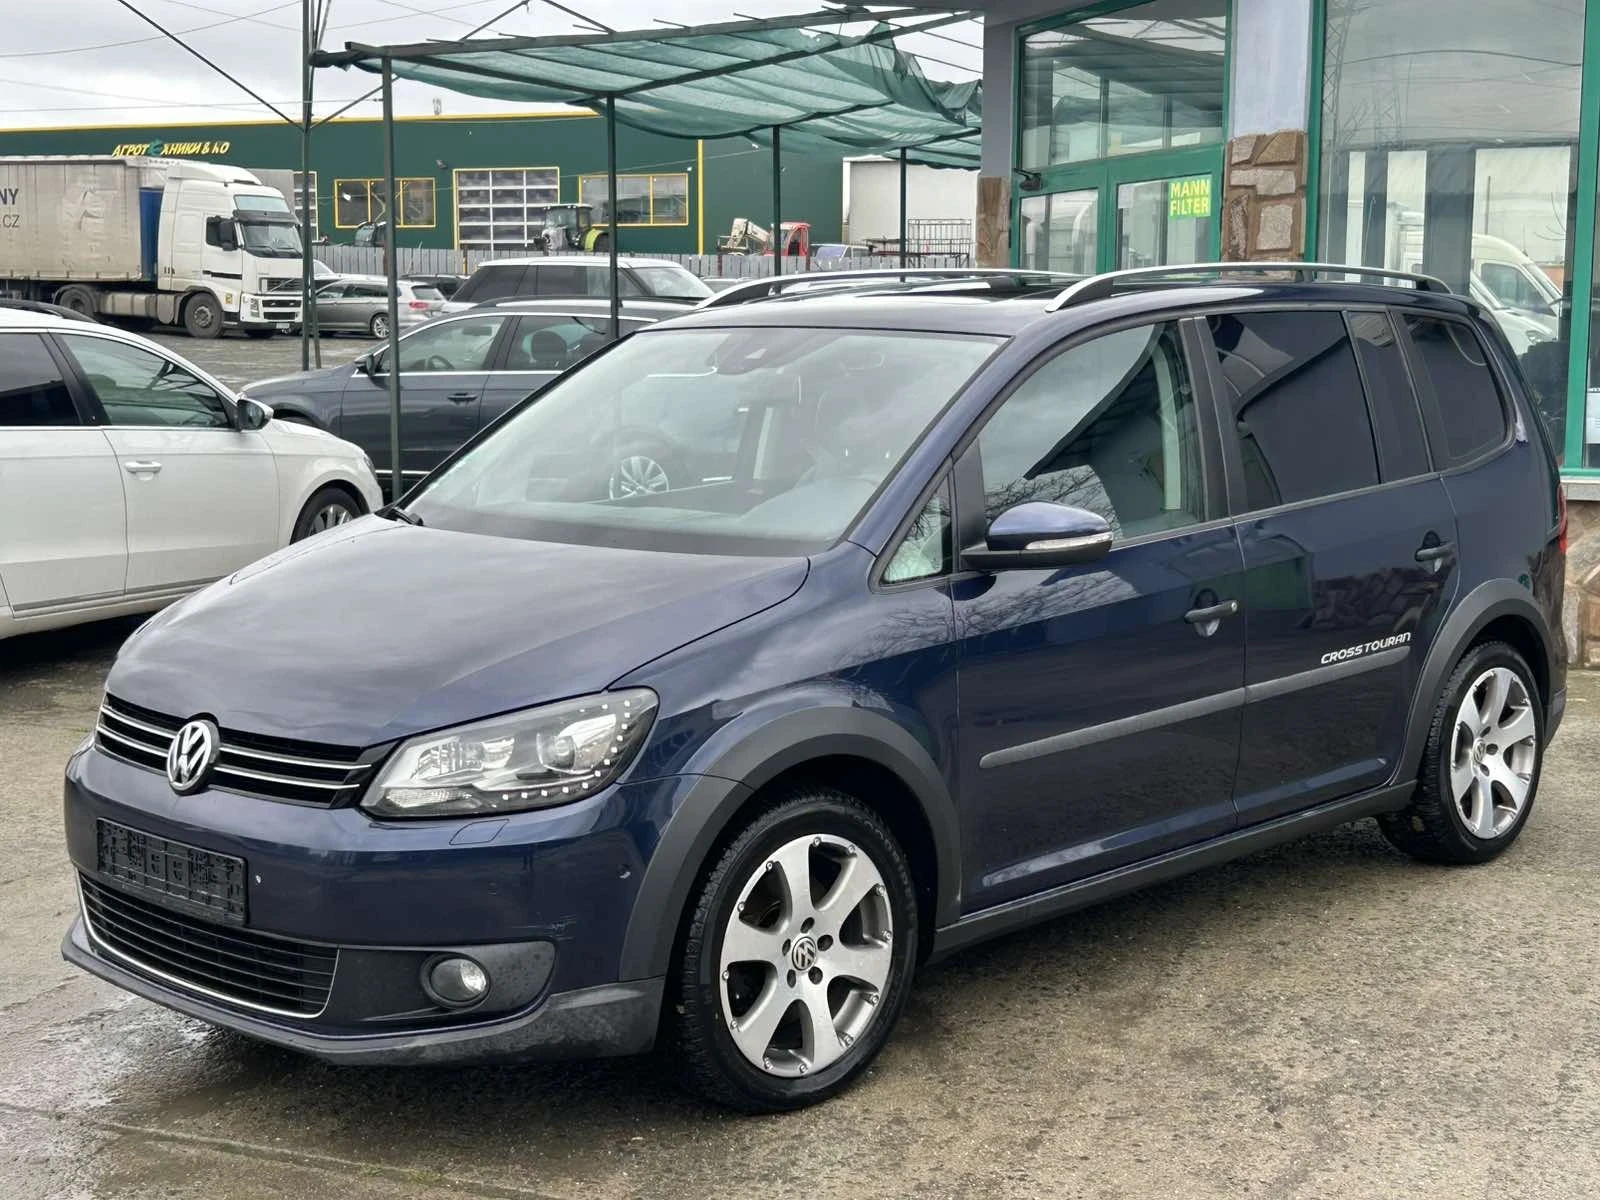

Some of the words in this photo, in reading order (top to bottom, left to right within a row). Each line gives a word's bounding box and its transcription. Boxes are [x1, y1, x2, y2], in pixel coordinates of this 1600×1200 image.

[212, 141, 230, 154] КО
[1170, 179, 1210, 198] MANN
[1170, 197, 1209, 216] FILTER
